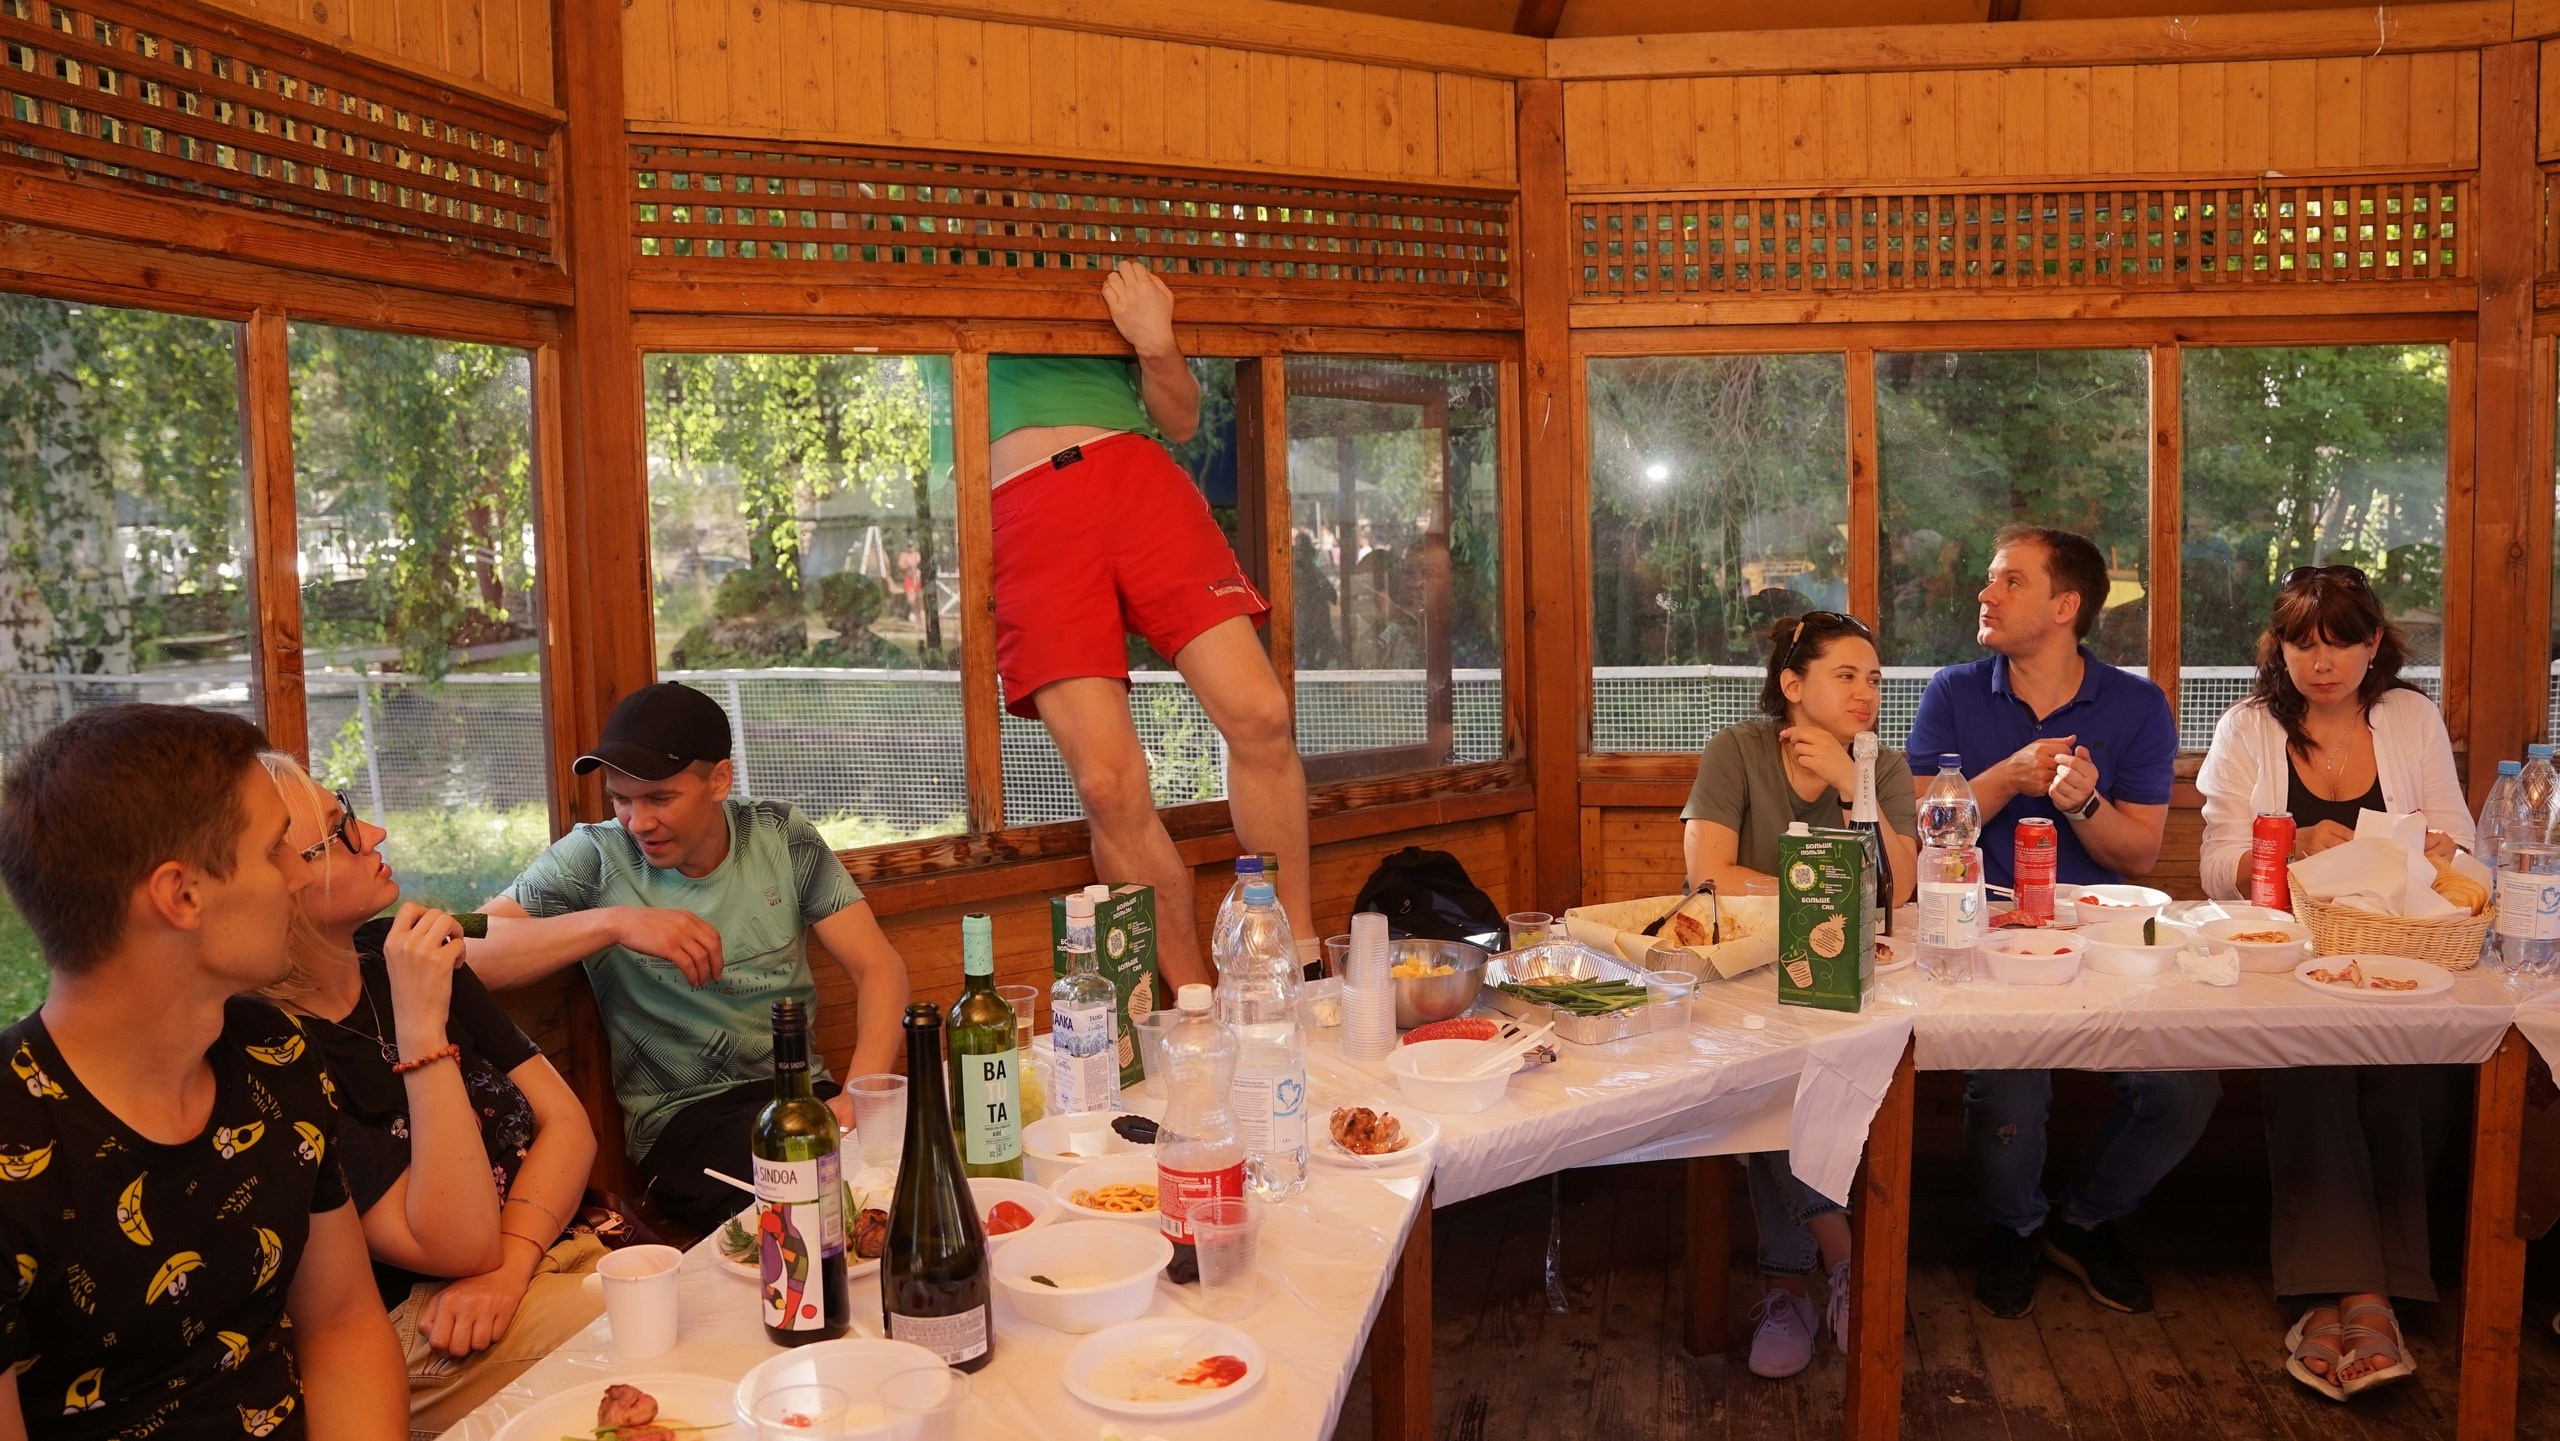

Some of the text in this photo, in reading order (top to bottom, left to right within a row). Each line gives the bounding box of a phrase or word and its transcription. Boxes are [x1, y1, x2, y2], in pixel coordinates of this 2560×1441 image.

[1805, 842, 1833, 850] БОЛЬШЕ
[983, 1059, 1007, 1082] BA
[985, 1080, 1009, 1103] TU
[986, 1102, 1008, 1124] TA
[760, 1166, 798, 1185] SINDOA
